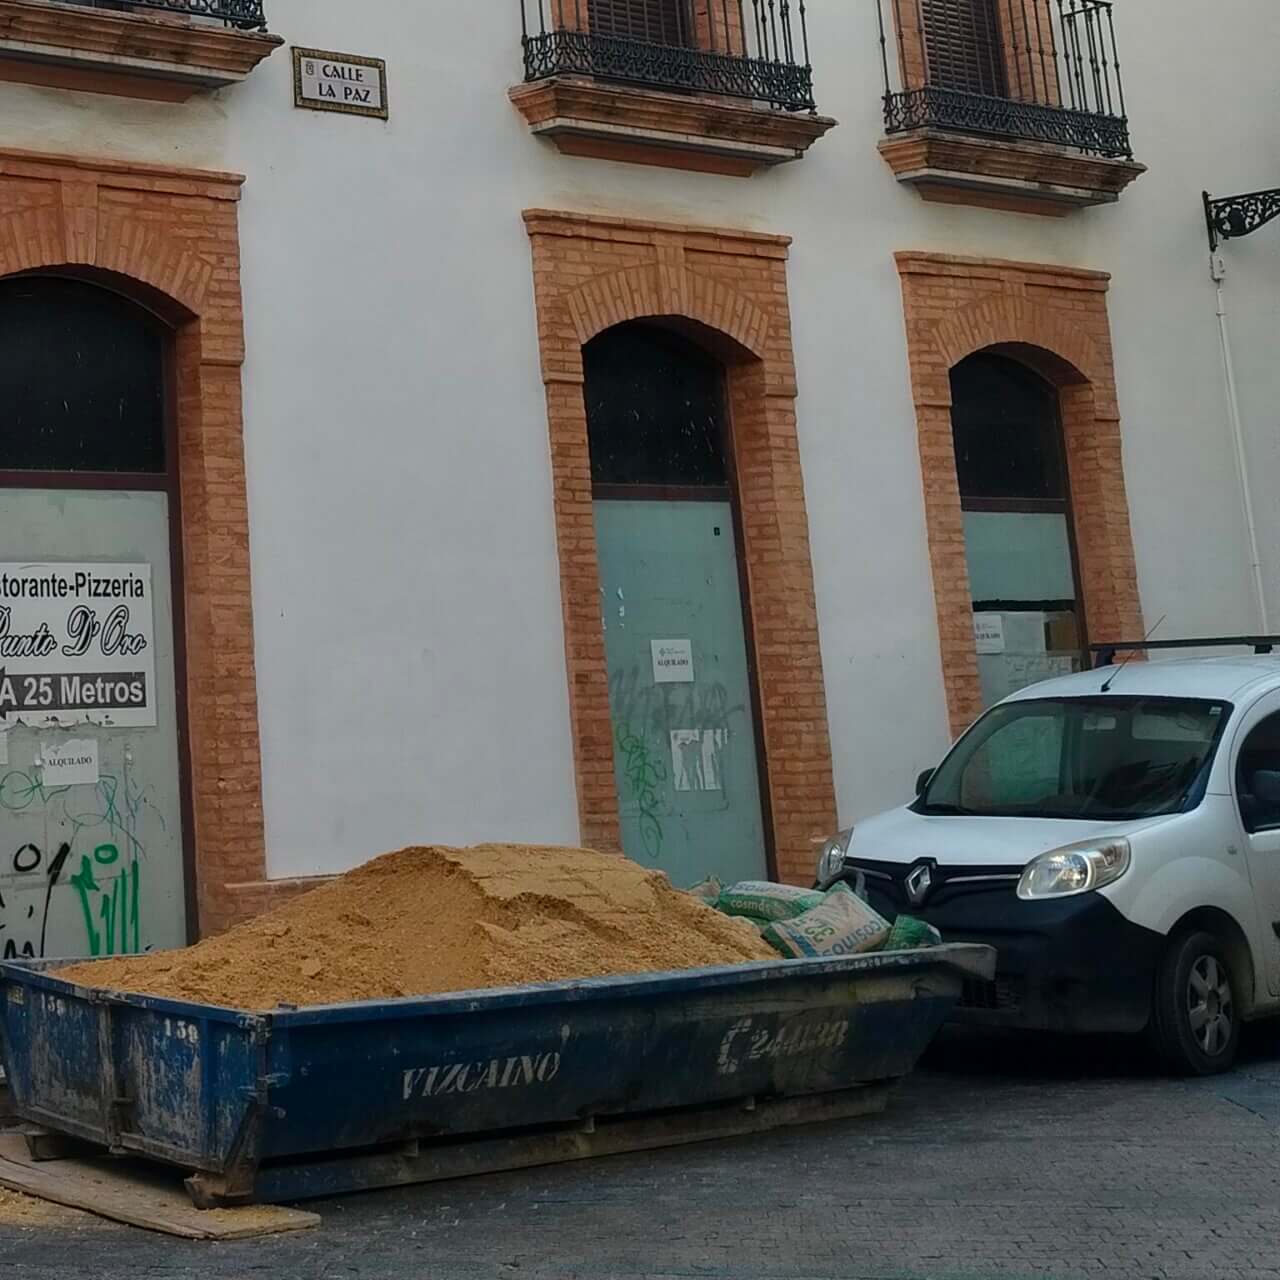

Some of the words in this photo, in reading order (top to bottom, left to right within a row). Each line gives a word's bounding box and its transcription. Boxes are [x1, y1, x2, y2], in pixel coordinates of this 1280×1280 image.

[322, 64, 364, 82] CALLE
[319, 83, 336, 98] LA
[344, 86, 371, 103] PAZ
[23, 677, 52, 705] 25
[60, 677, 143, 704] Metros
[47, 756, 92, 768] ALQUILADO
[402, 1052, 561, 1100] VIZCAINO
